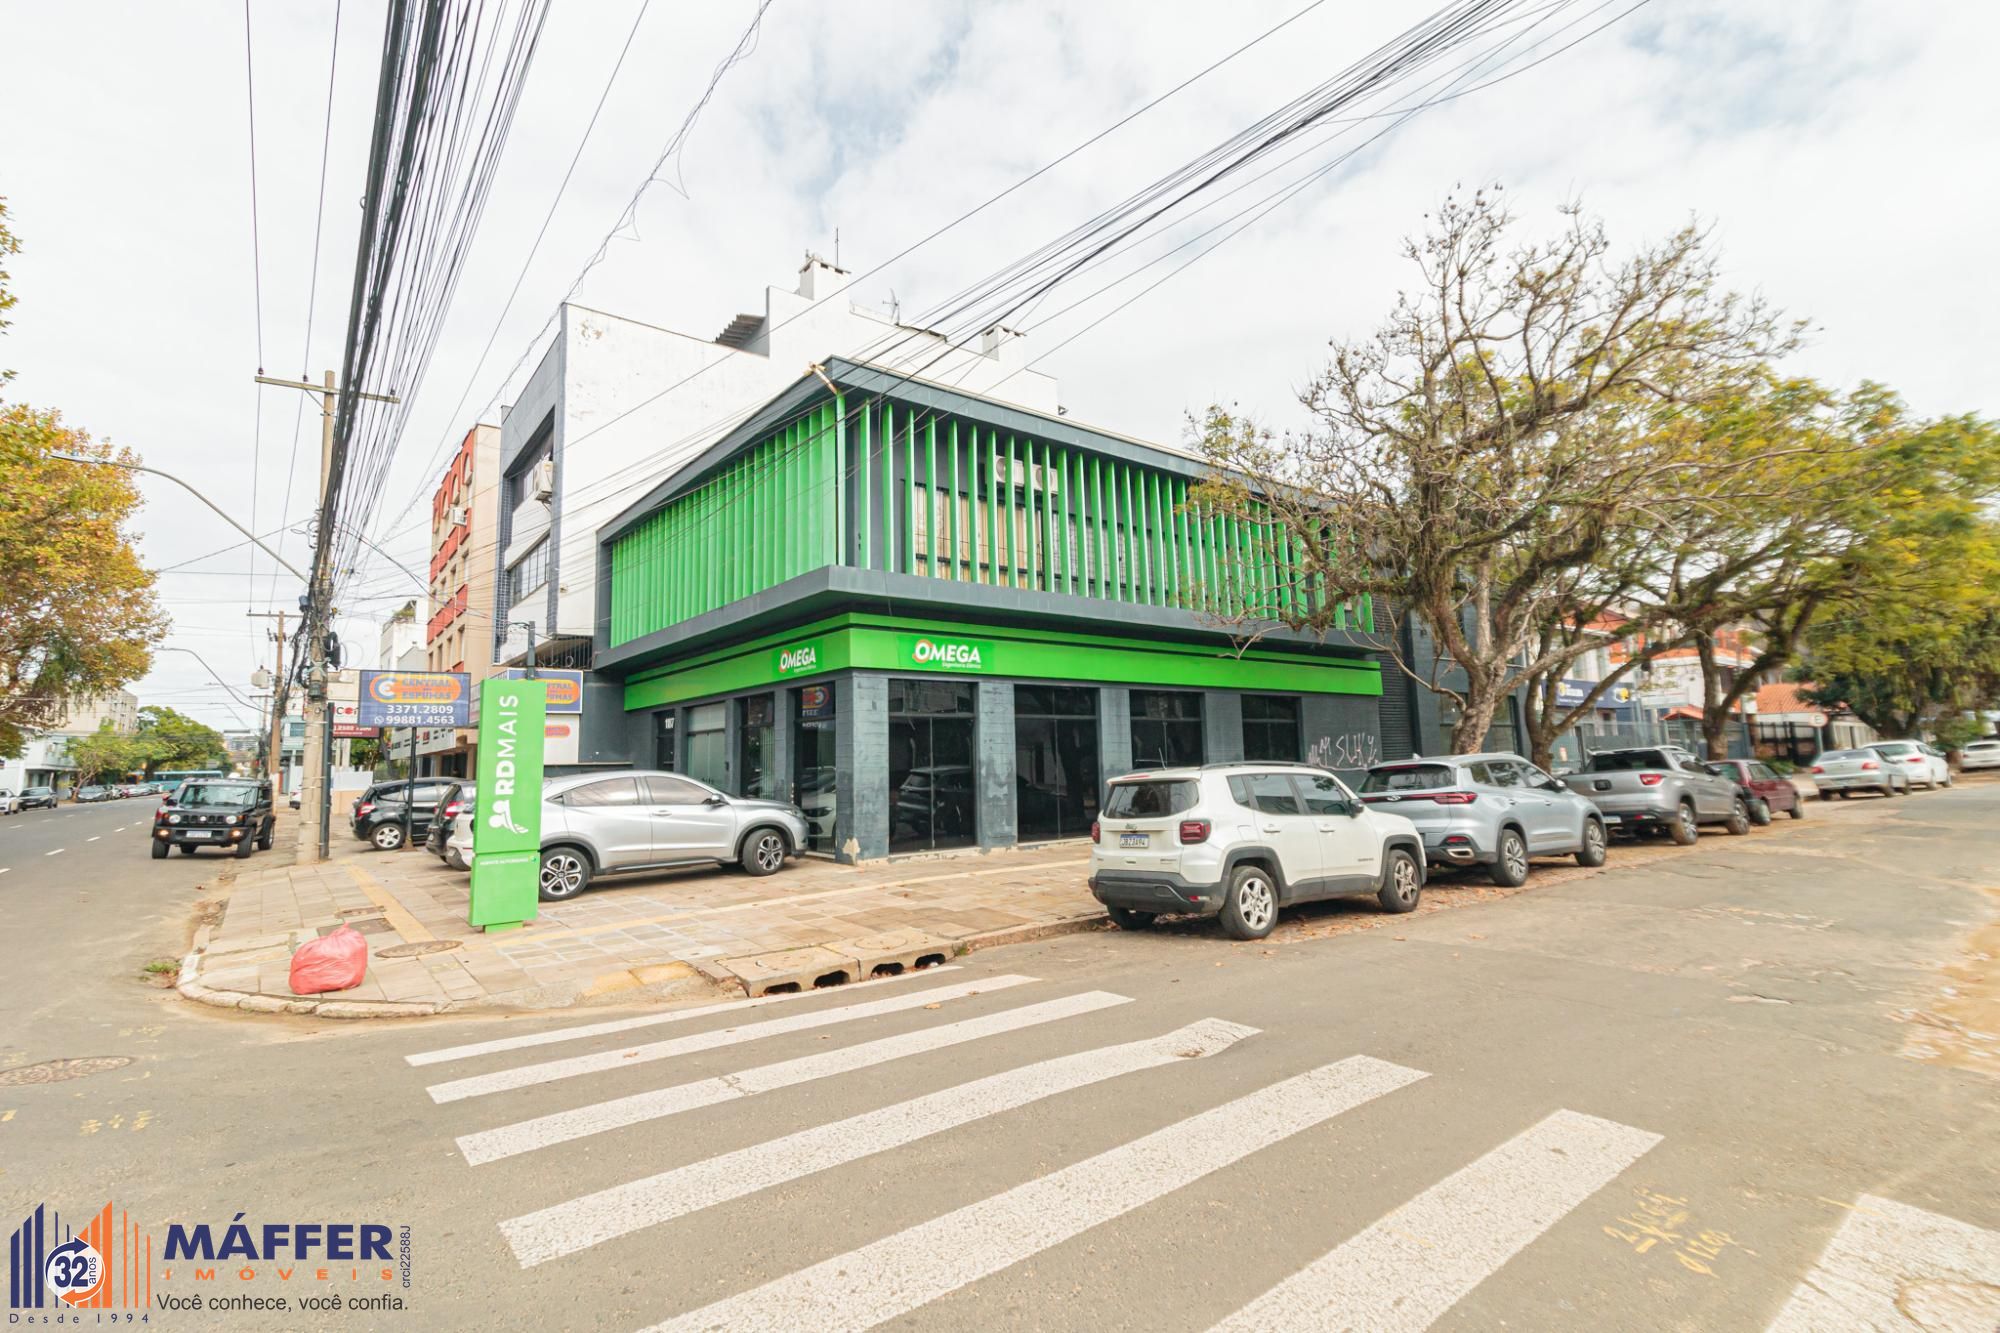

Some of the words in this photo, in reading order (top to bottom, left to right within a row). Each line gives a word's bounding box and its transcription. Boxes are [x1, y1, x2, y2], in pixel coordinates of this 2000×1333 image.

[780, 647, 816, 669] OMEGA
[914, 642, 982, 663] OMEGA
[387, 704, 454, 714] 3371.2809
[385, 715, 455, 725] 99881.4563
[495, 695, 518, 796] RDMAIS
